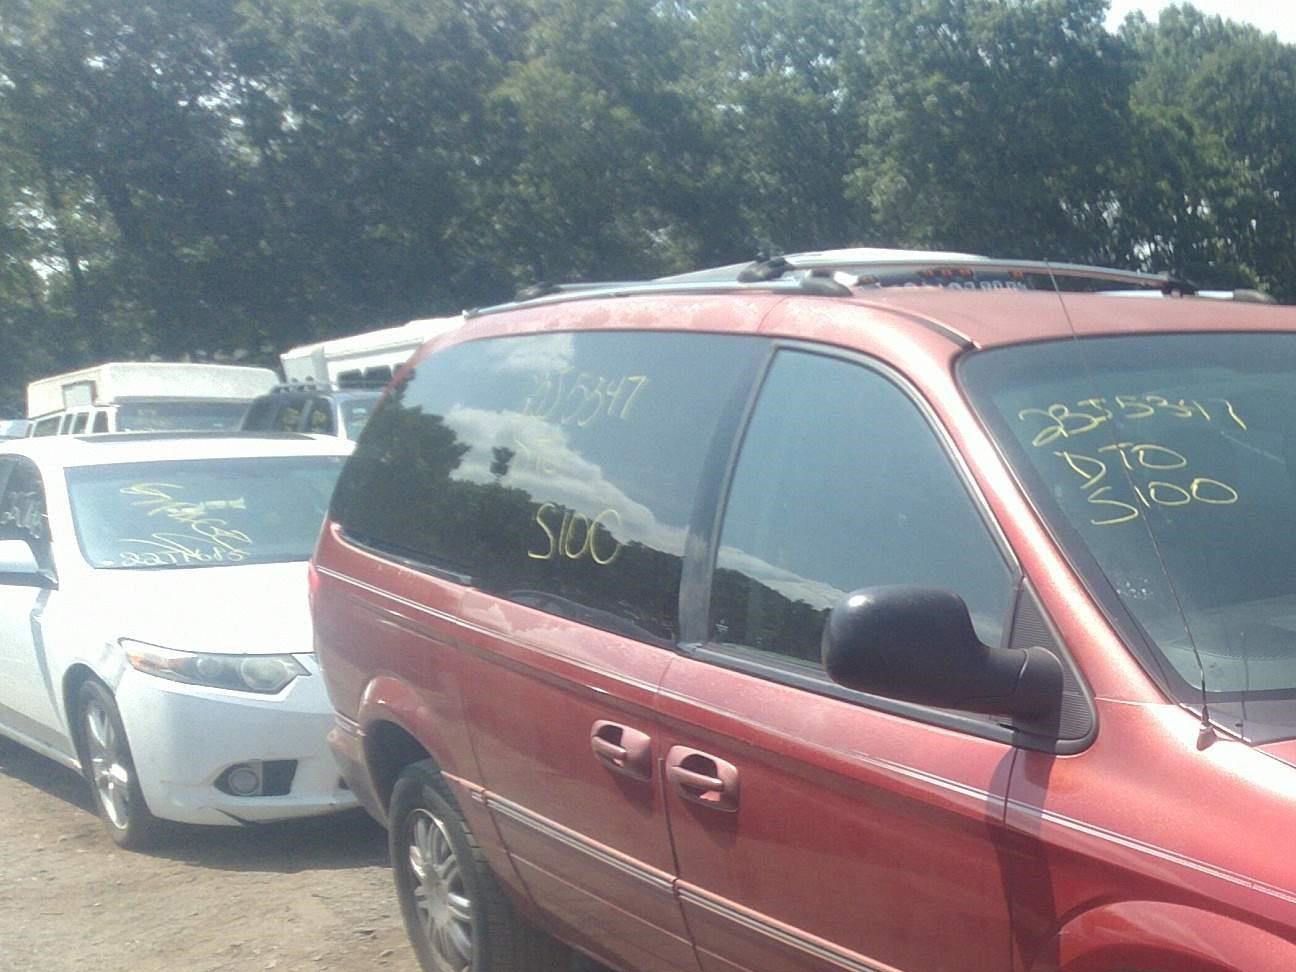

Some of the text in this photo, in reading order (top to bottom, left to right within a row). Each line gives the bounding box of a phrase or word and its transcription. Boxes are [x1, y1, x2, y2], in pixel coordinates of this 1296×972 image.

[1053, 441, 1188, 490] DTO
[1088, 477, 1239, 526] S100
[527, 502, 622, 566] S100
